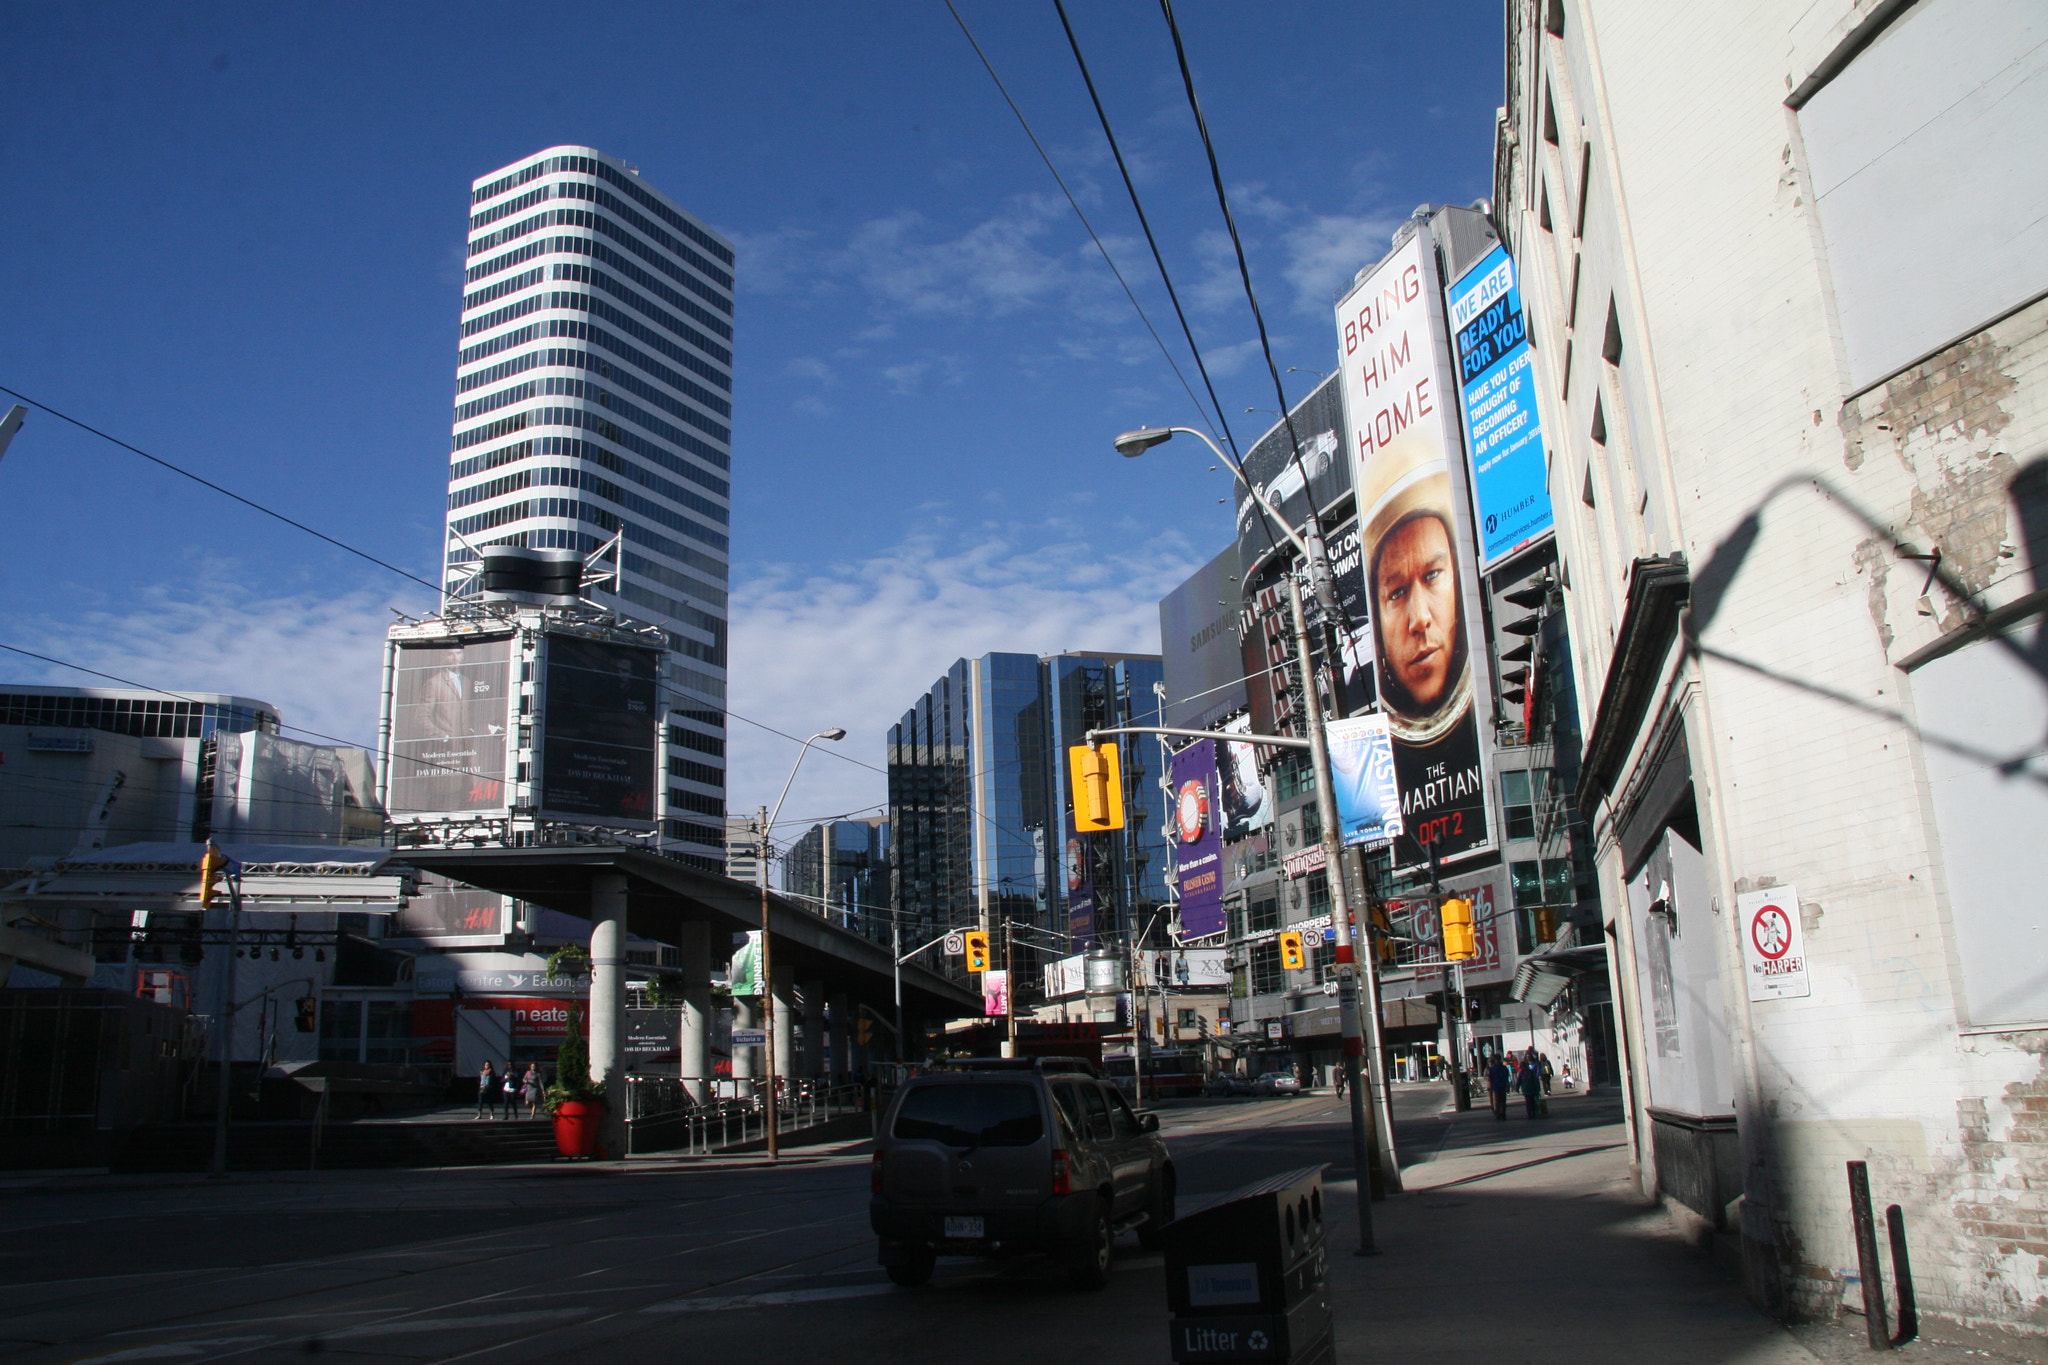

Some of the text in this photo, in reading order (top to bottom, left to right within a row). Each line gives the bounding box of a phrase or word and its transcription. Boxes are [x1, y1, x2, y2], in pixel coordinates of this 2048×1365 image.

[1344, 264, 1420, 356] BRING
[1456, 265, 1508, 325] WE ARE
[1459, 299, 1507, 355] READY
[1362, 330, 1411, 397] HIM
[1462, 315, 1524, 380] FOR YOU
[1468, 350, 1531, 406] HAVE YOU EVER
[1470, 376, 1521, 422] THOUGHT OF
[1358, 377, 1433, 462] HOME
[1473, 399, 1518, 440] BECOMING
[1475, 411, 1528, 457] AN OFFICER?
[1478, 460, 1491, 474] Apply
[1491, 453, 1502, 465] now
[1502, 448, 1510, 458] for
[1509, 435, 1528, 453] January
[1501, 495, 1535, 522] HUMBER
[1344, 529, 1360, 552] ON
[1191, 609, 1235, 653] SAMSUNG
[474, 685, 490, 693] $129
[416, 766, 481, 777] DAVID BECKHAM
[422, 749, 477, 759] Modern Essentials
[1426, 762, 1446, 780] THE
[468, 781, 499, 802] H&M
[568, 769, 631, 783] DAVID BECKHAM
[1371, 734, 1404, 838] TASTING
[1400, 765, 1480, 816] MARTIAN
[1419, 816, 1449, 845] OCT
[1453, 812, 1463, 835] 2
[1179, 864, 1189, 872] More
[464, 907, 496, 929] H&M
[459, 974, 503, 988] Centre
[532, 974, 571, 988] Eaton
[754, 940, 763, 995] LEARNING
[1753, 957, 1803, 975] No HARPER
[1000, 978, 1008, 1015] THE ARTS
[530, 1007, 584, 1022] eatey
[1185, 1327, 1239, 1352] Litter
